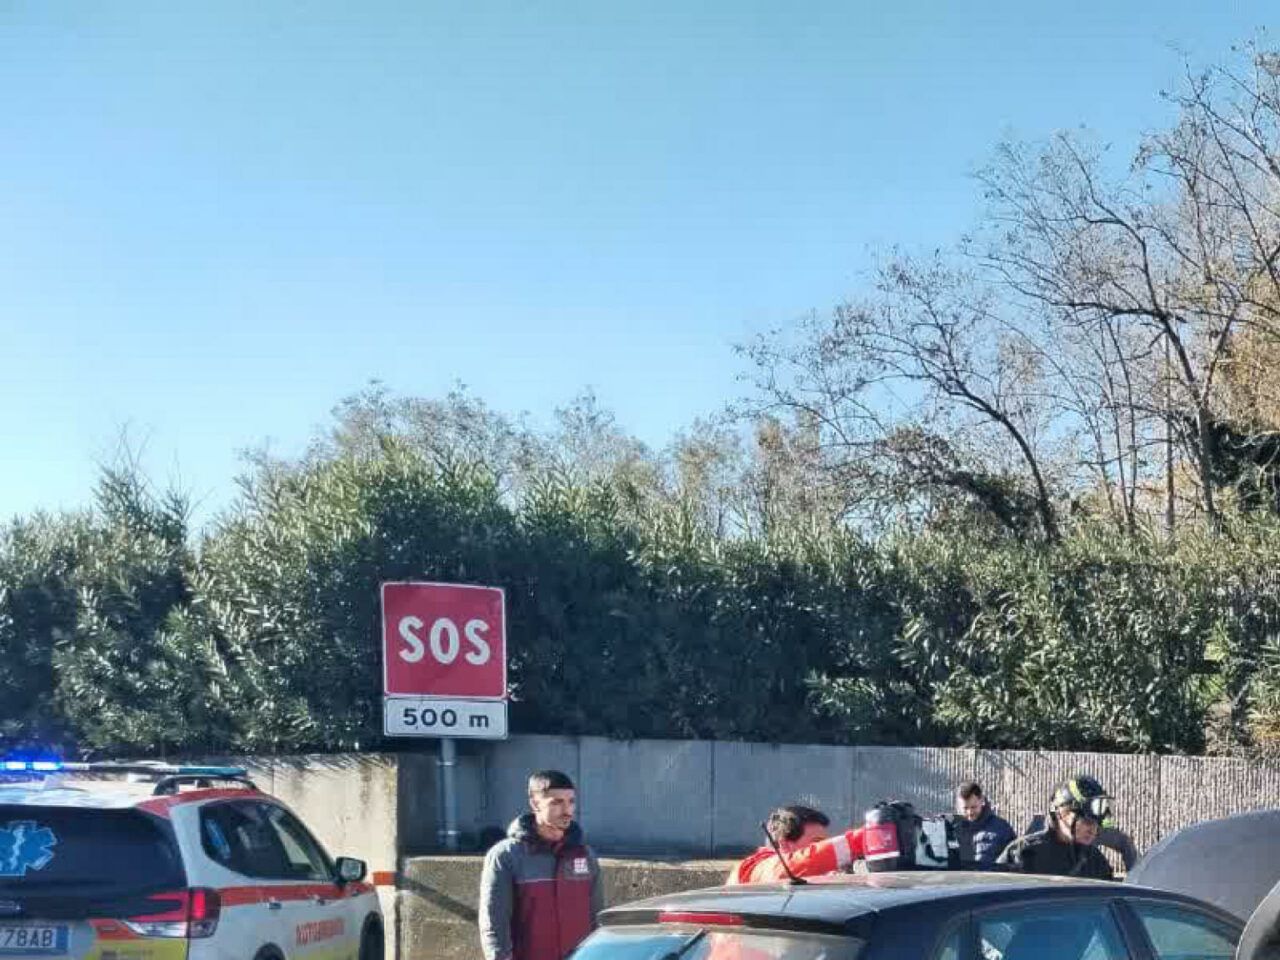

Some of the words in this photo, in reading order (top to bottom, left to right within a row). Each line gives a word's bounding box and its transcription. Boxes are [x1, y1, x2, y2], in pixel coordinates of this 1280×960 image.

[398, 616, 491, 665] SOS
[403, 708, 457, 728] 500
[469, 715, 489, 728] m
[0, 929, 53, 947] 78AB
